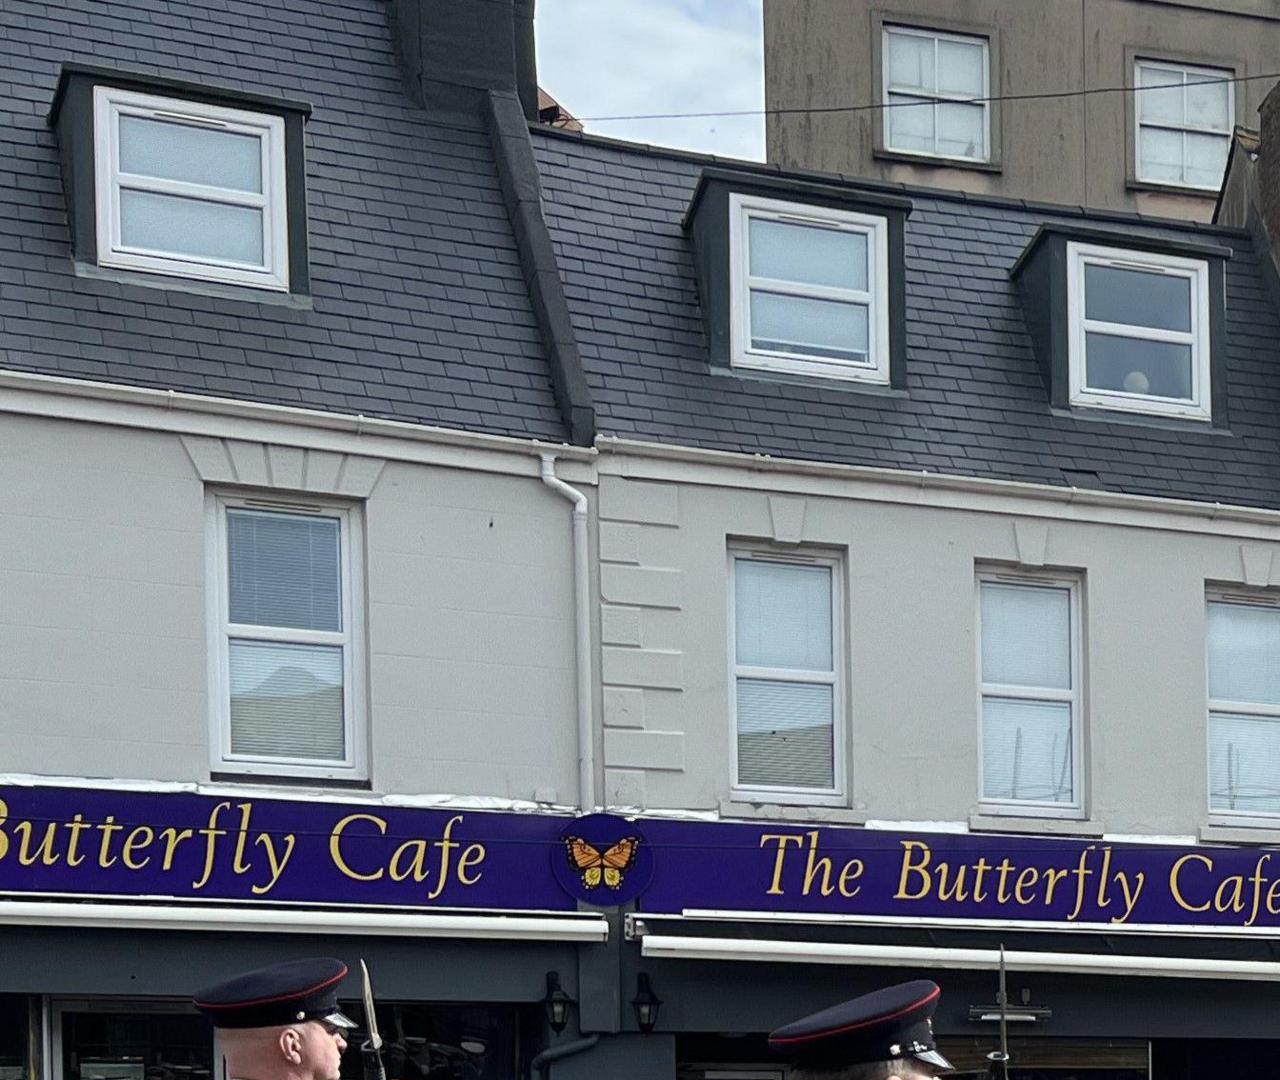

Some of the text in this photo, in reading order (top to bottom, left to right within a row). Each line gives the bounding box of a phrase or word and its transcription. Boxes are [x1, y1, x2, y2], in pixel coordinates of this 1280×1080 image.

[0, 798, 486, 899] utterfly Cafe
[760, 831, 864, 899] The
[893, 839, 1145, 923] Butterfly
